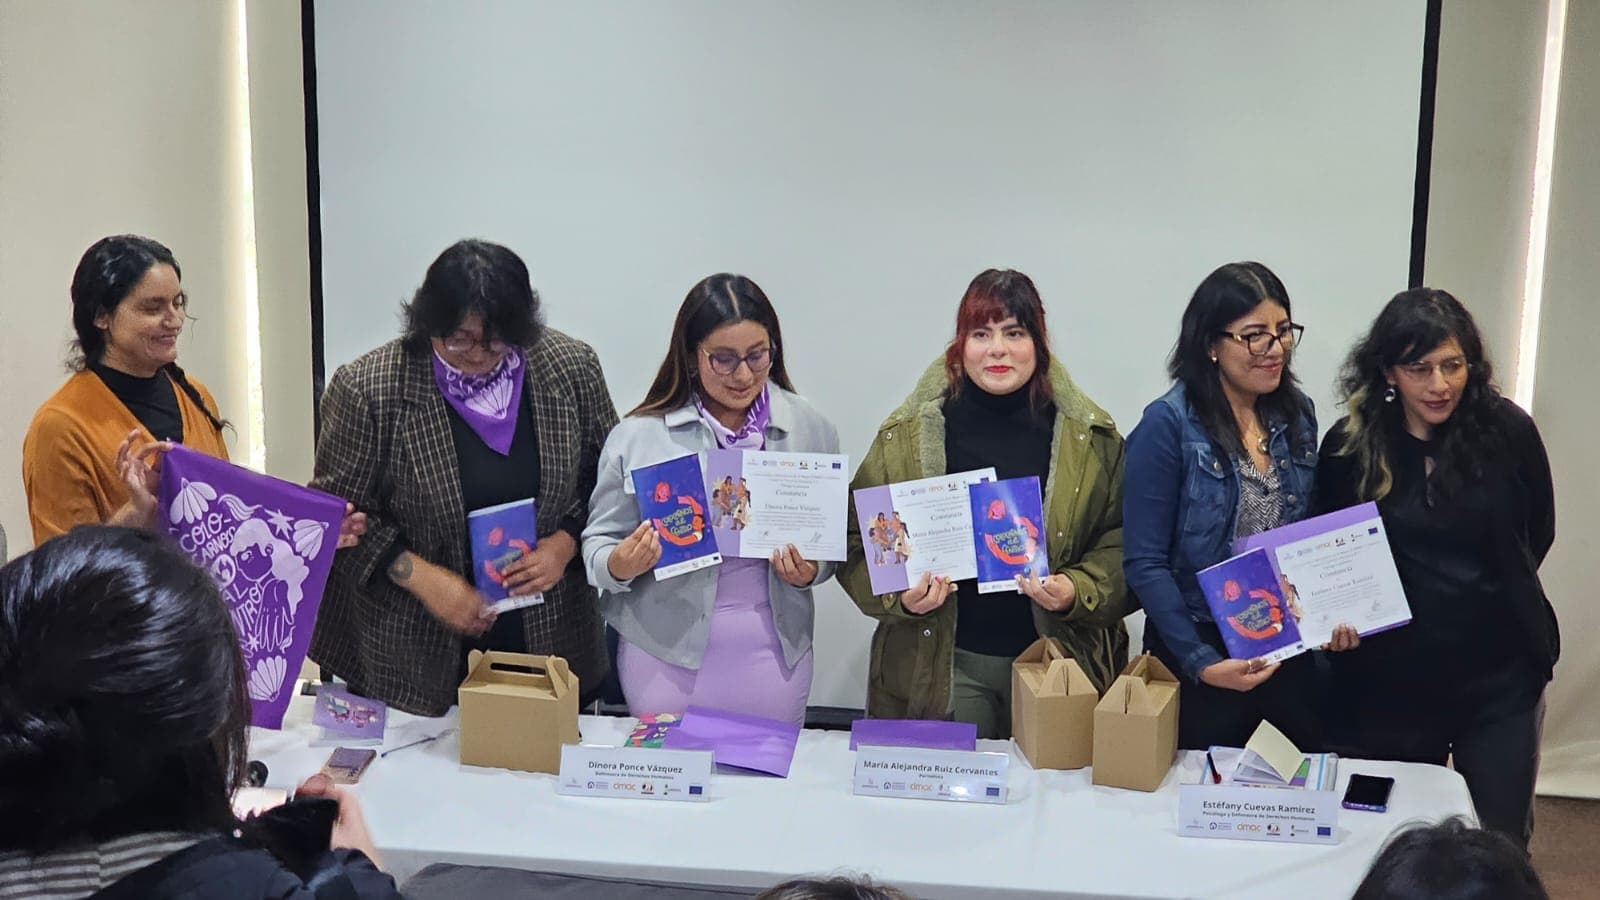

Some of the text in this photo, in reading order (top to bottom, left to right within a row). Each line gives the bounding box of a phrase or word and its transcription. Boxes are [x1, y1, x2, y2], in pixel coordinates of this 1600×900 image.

[588, 761, 683, 775] Dinora Ponce Vázquez
[863, 760, 999, 777] María Alejandra Ruiz Cervantes
[1202, 800, 1316, 814] Estéfany Cuevas Ramírez
